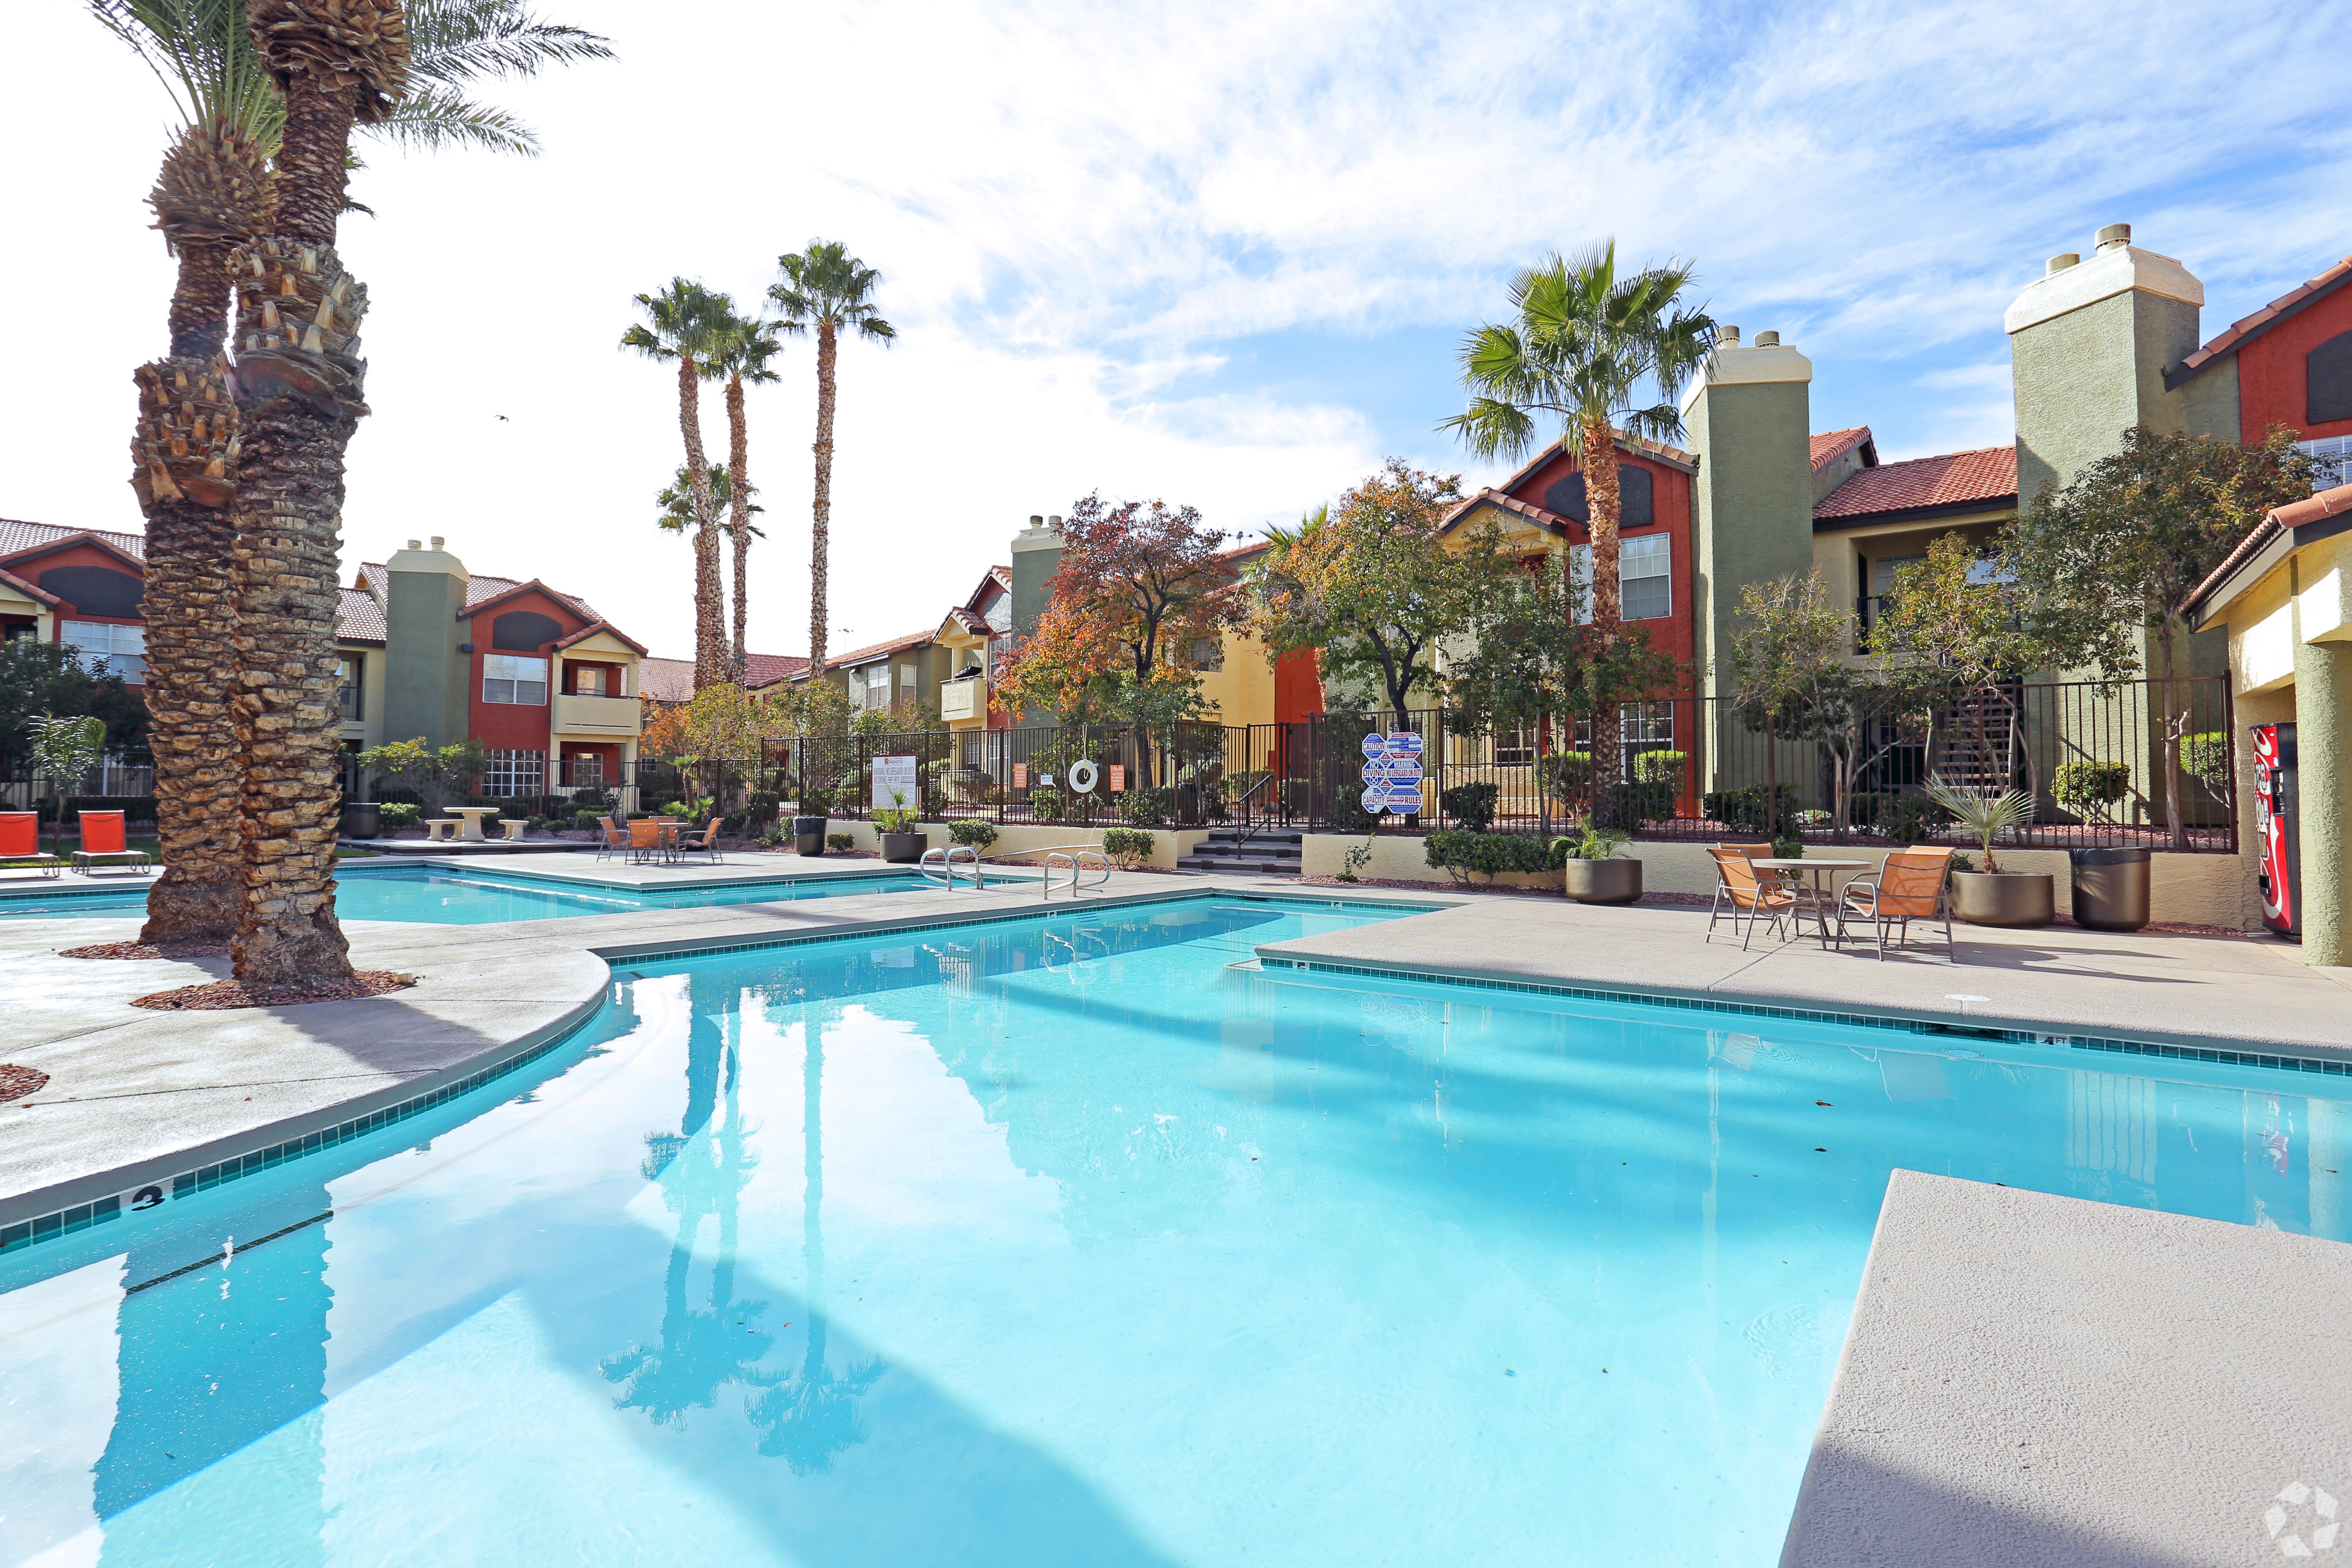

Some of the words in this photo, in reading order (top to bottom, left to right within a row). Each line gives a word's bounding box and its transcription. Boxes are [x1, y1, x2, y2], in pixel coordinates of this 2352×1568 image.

[904, 767, 907, 775] ON
[2040, 1037, 2056, 1045] 4
[131, 1186, 165, 1211] 3
